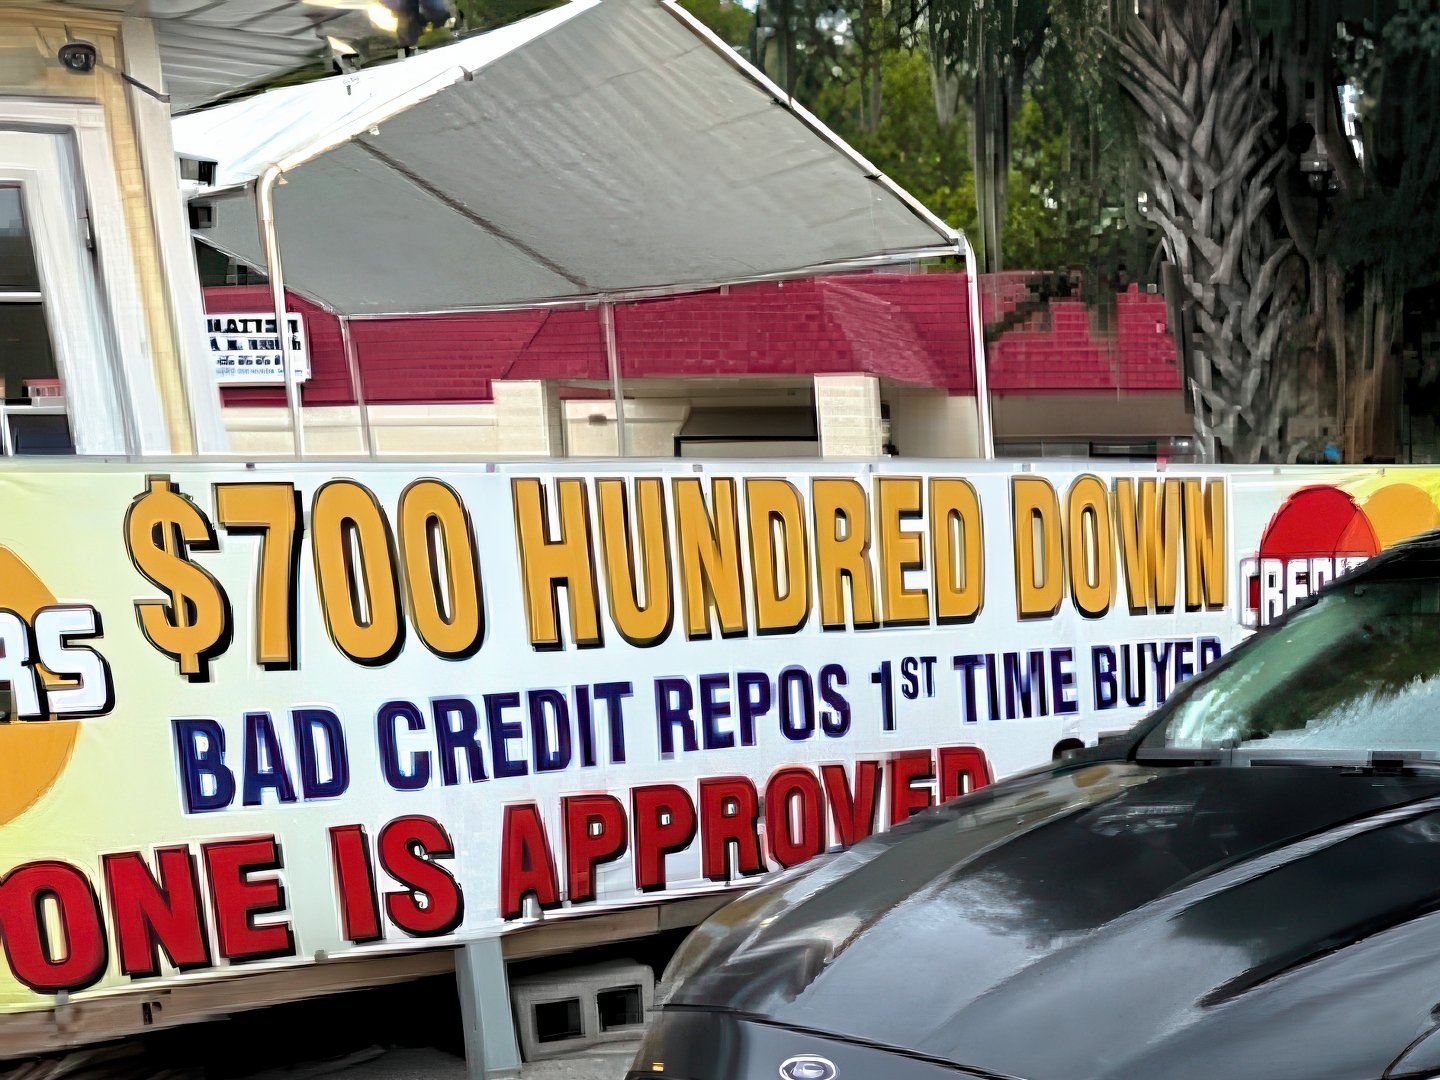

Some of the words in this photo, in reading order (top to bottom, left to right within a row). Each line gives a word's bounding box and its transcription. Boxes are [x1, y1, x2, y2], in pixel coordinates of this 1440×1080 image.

[123, 474, 488, 682] $700
[510, 476, 985, 652] HUNDRED
[1010, 473, 1226, 622] DOWN
[1240, 556, 1368, 627] CRED
[170, 705, 350, 814] BAD
[376, 680, 634, 792] CREDIT
[653, 663, 852, 754] REPOS
[871, 655, 938, 733] 1ST
[953, 645, 1080, 723] TIME
[0, 834, 296, 994] ONE
[326, 814, 465, 943] IS
